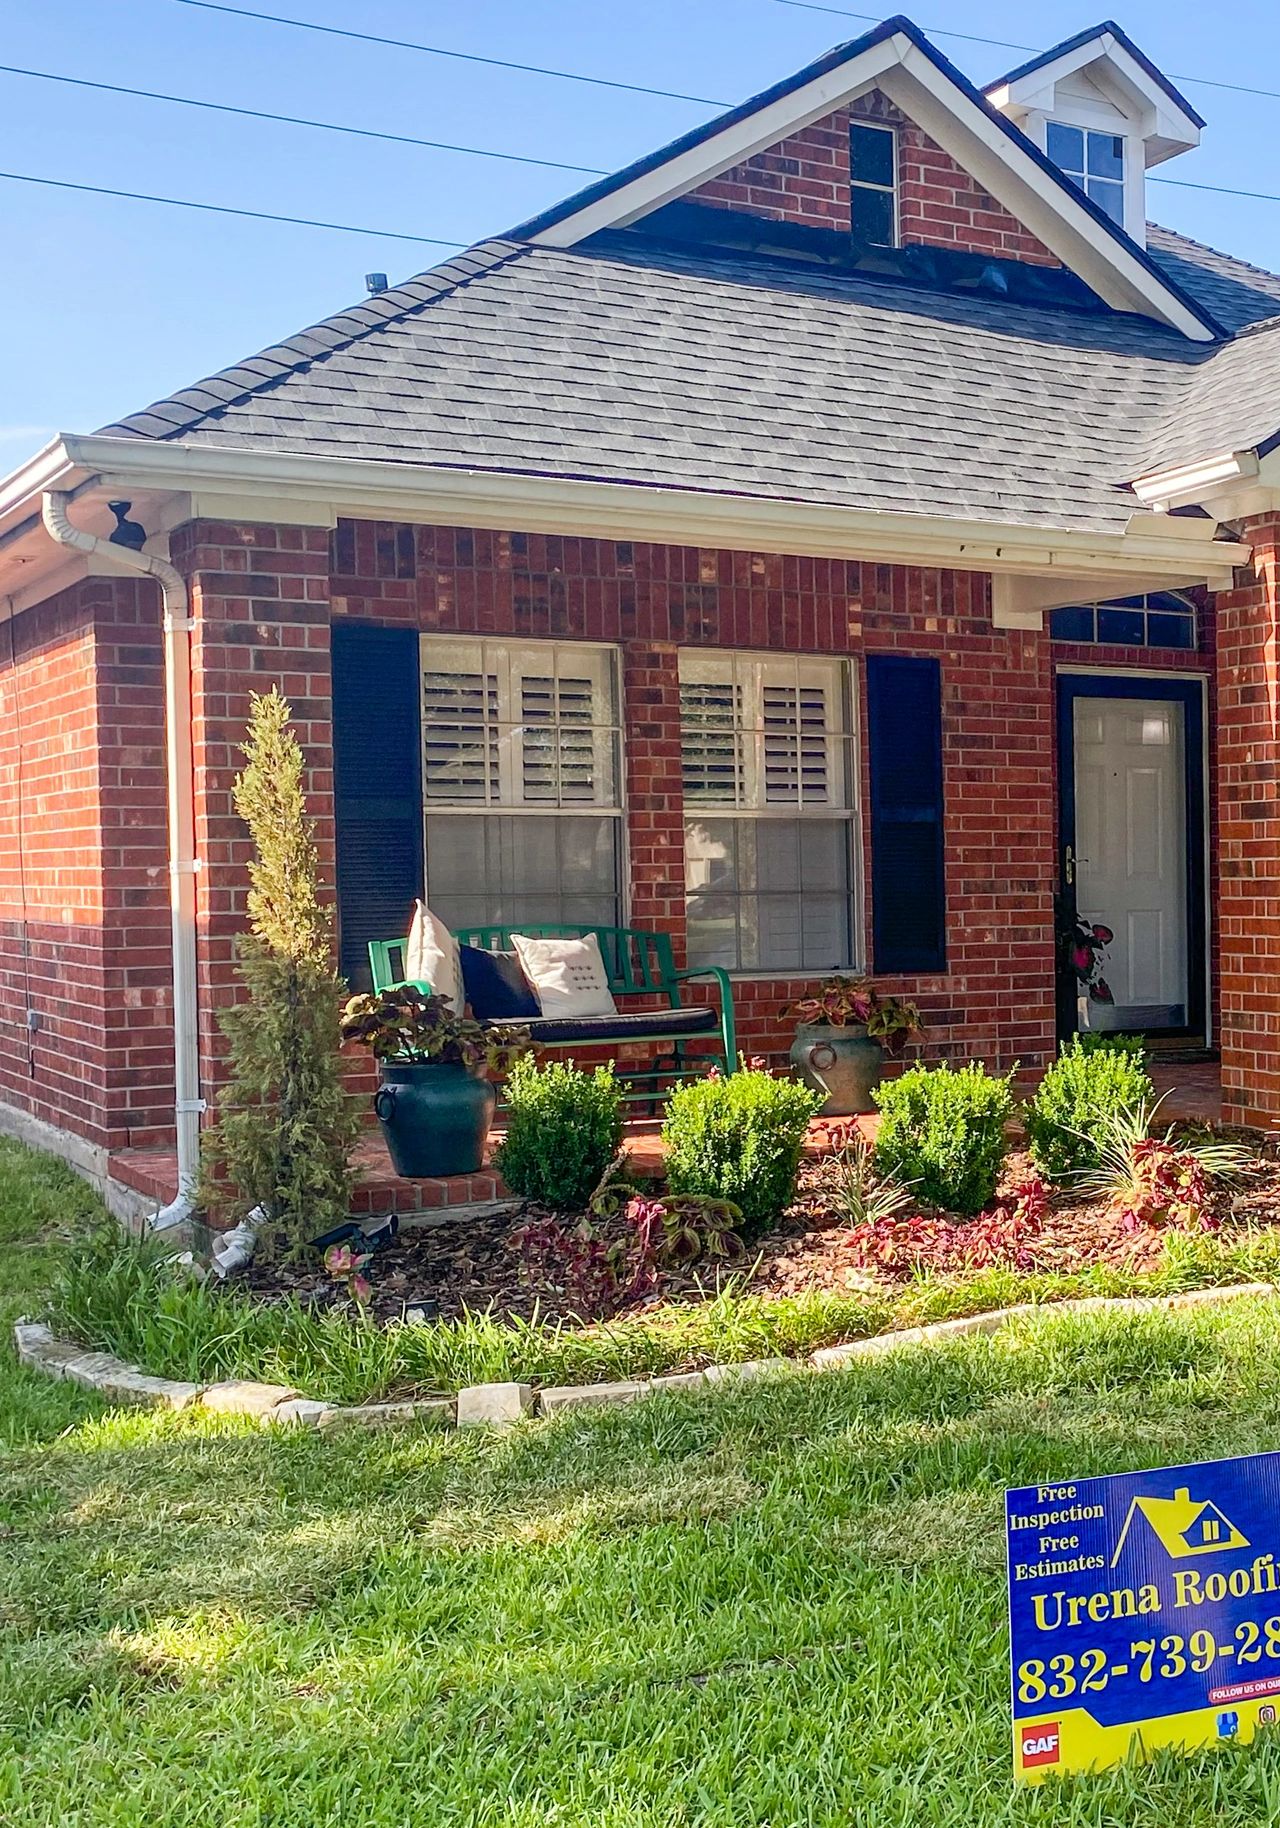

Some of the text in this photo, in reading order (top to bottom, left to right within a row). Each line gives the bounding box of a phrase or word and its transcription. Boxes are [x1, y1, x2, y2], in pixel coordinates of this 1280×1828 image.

[1037, 1484, 1077, 1504] Free
[1010, 1504, 1104, 1531] Inspection
[1039, 1534, 1079, 1553] Free
[1015, 1555, 1105, 1581] Estimates
[1031, 1584, 1162, 1632] Urena
[1212, 1687, 1244, 1700] FOLLOW
[1244, 1685, 1254, 1693] US
[1255, 1682, 1266, 1691] ON
[1023, 1735, 1059, 1756] GAF
